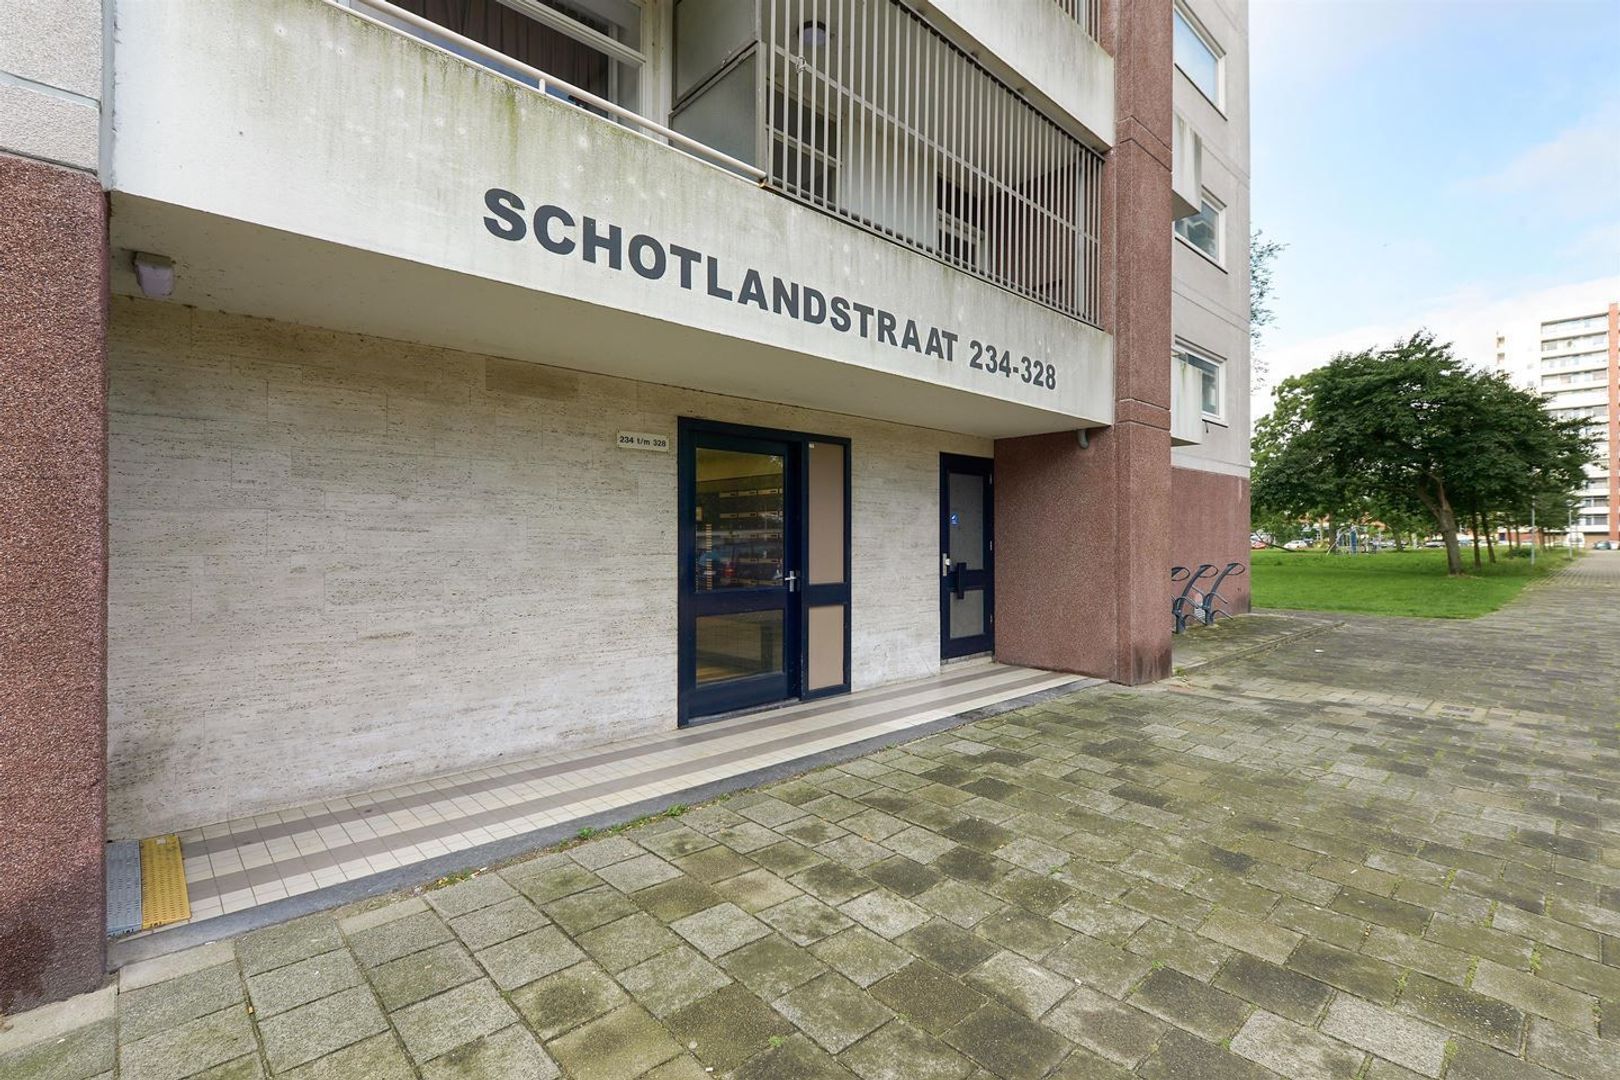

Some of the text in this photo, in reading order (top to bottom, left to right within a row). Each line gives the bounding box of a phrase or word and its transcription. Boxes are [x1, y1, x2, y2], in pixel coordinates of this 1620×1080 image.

[483, 187, 1057, 391] SCHOTLANDSTRAAT 234-328
[620, 435, 666, 447] 234 t/m 328
